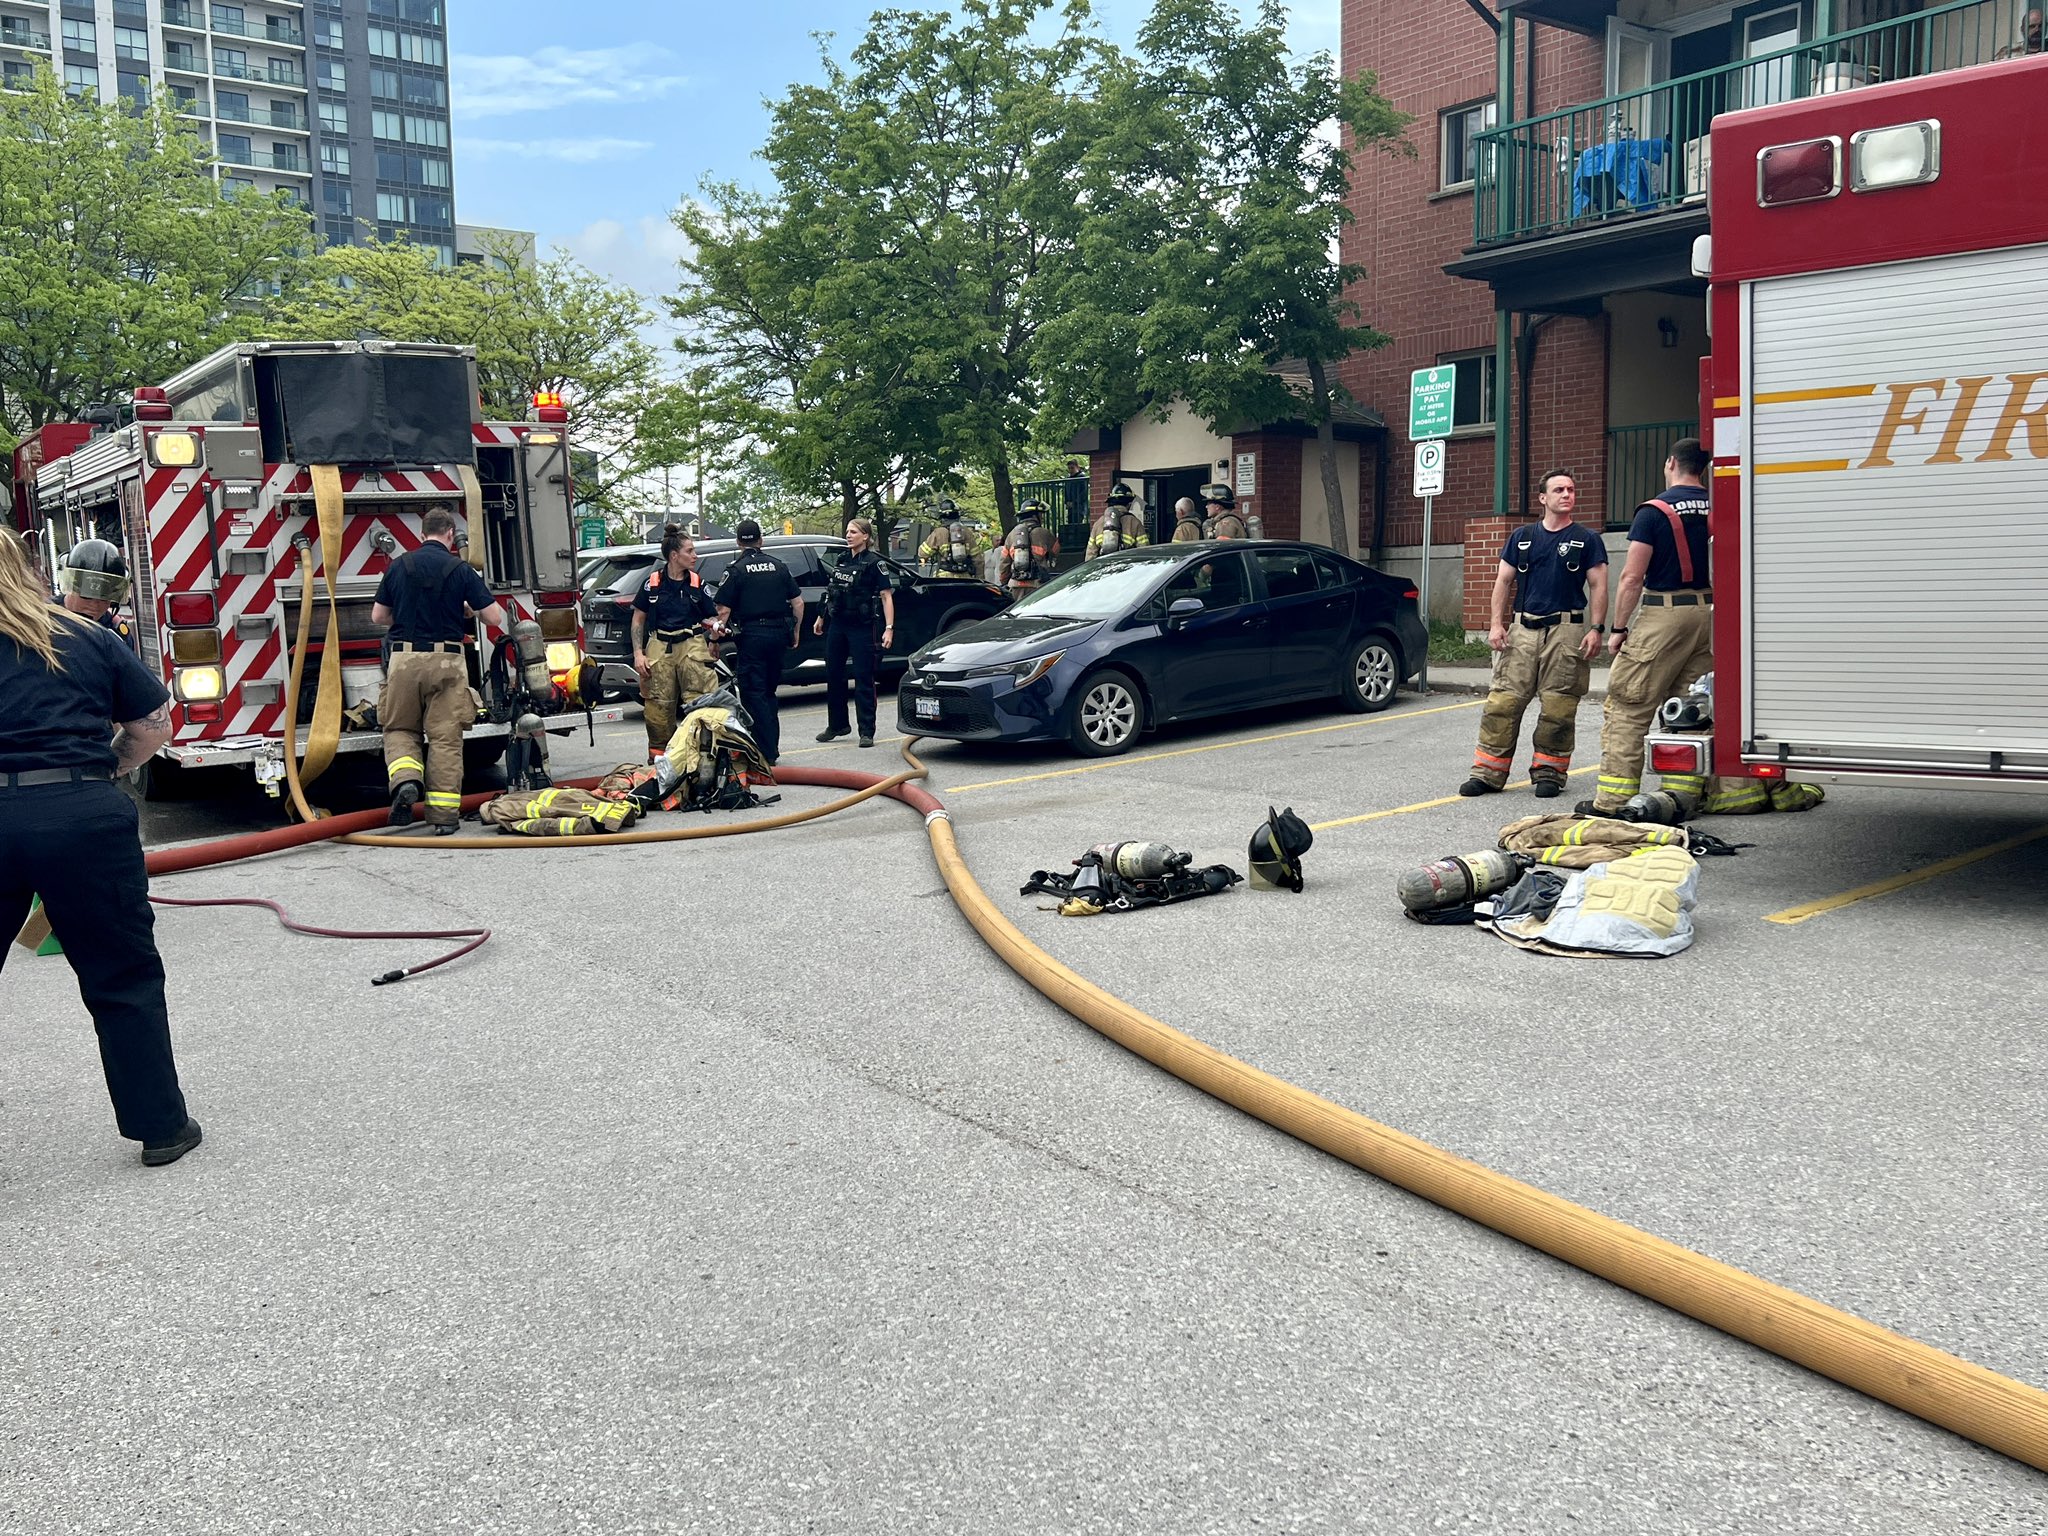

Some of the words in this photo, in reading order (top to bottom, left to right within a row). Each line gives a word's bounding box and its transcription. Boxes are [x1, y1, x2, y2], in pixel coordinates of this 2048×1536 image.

[1415, 381, 1451, 394] PARKING
[1423, 395, 1440, 404] PAY
[1427, 402, 1445, 411] METER
[1415, 418, 1436, 426] MOBILE
[1426, 451, 1435, 464] P
[745, 562, 770, 573] POLICE
[834, 571, 850, 582] POLICE
